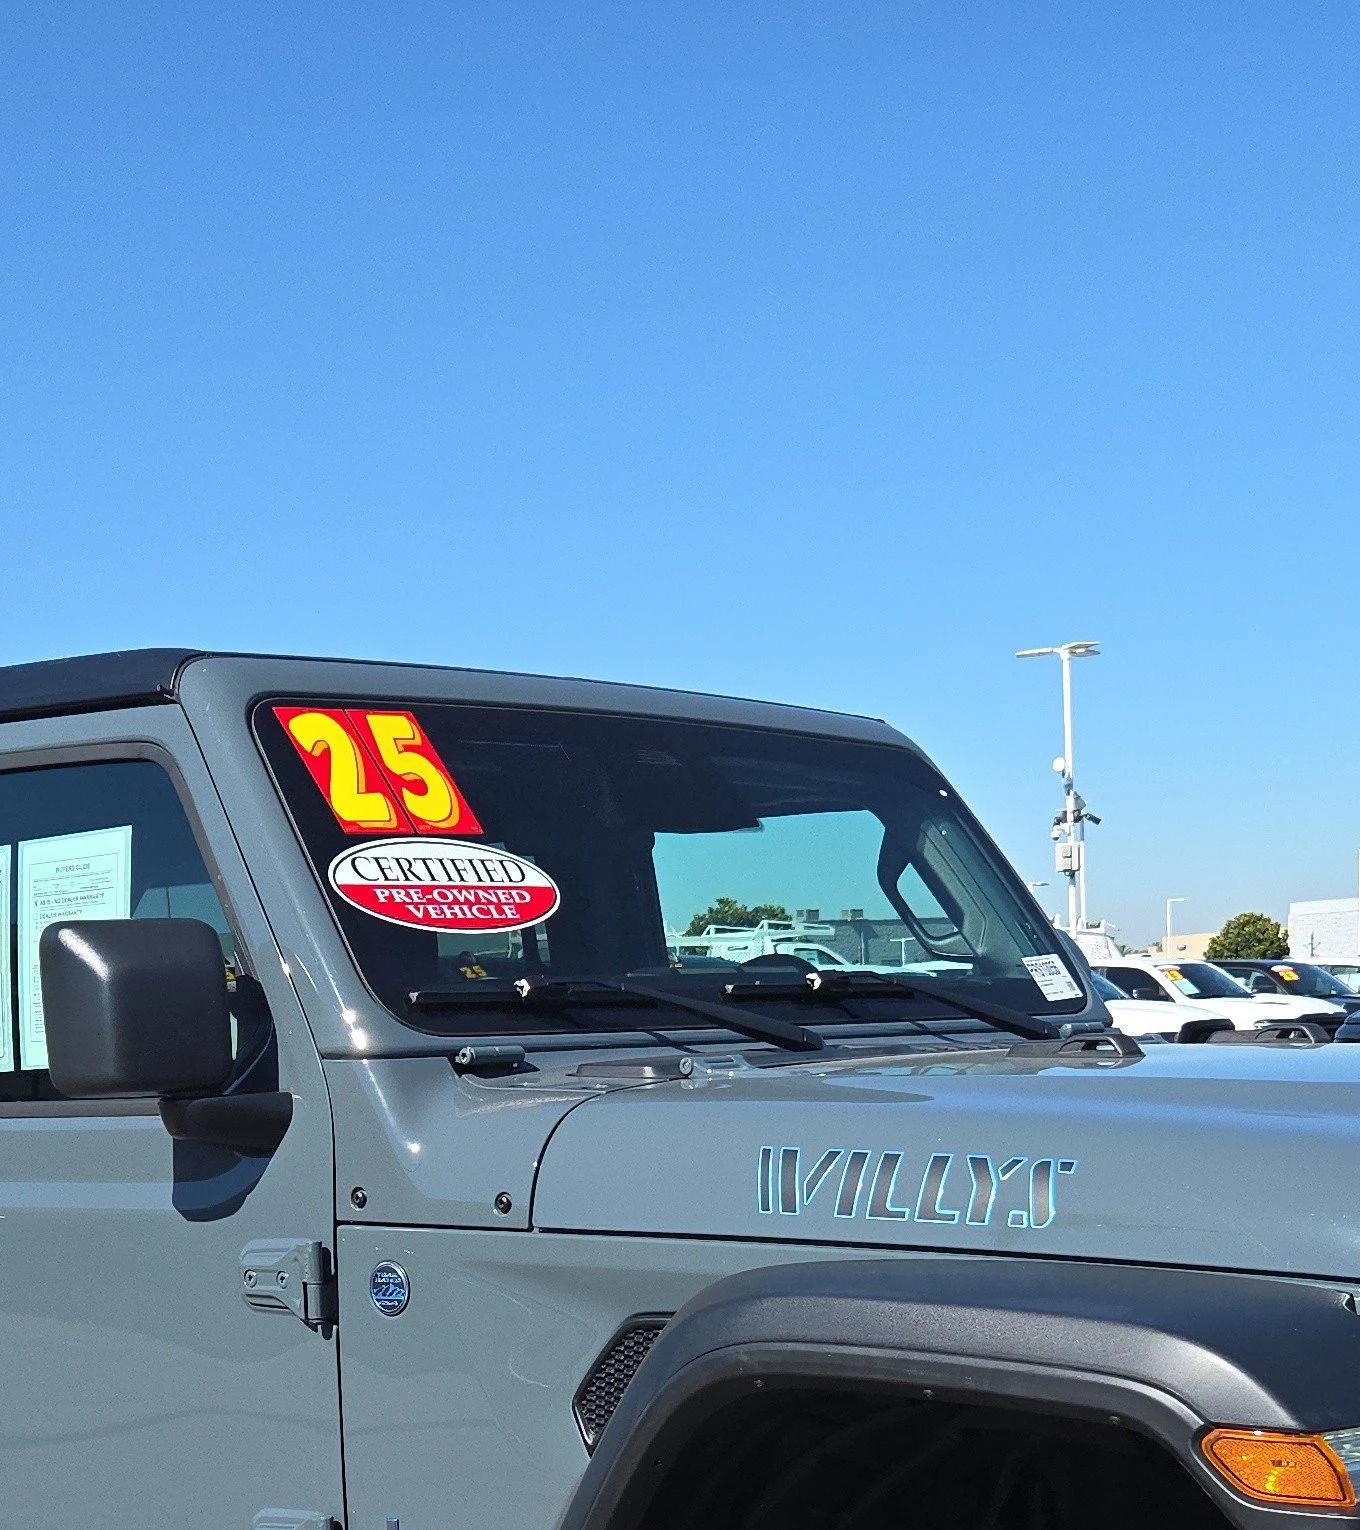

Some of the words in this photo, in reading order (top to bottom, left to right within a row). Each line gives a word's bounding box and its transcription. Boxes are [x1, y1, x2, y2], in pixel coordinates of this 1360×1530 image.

[288, 712, 460, 828] 25
[350, 856, 526, 884] CERTIFIED
[373, 888, 531, 904] PRE-OWNED
[405, 905, 520, 919] VEHICLE
[757, 1146, 1078, 1229] WILLYS
